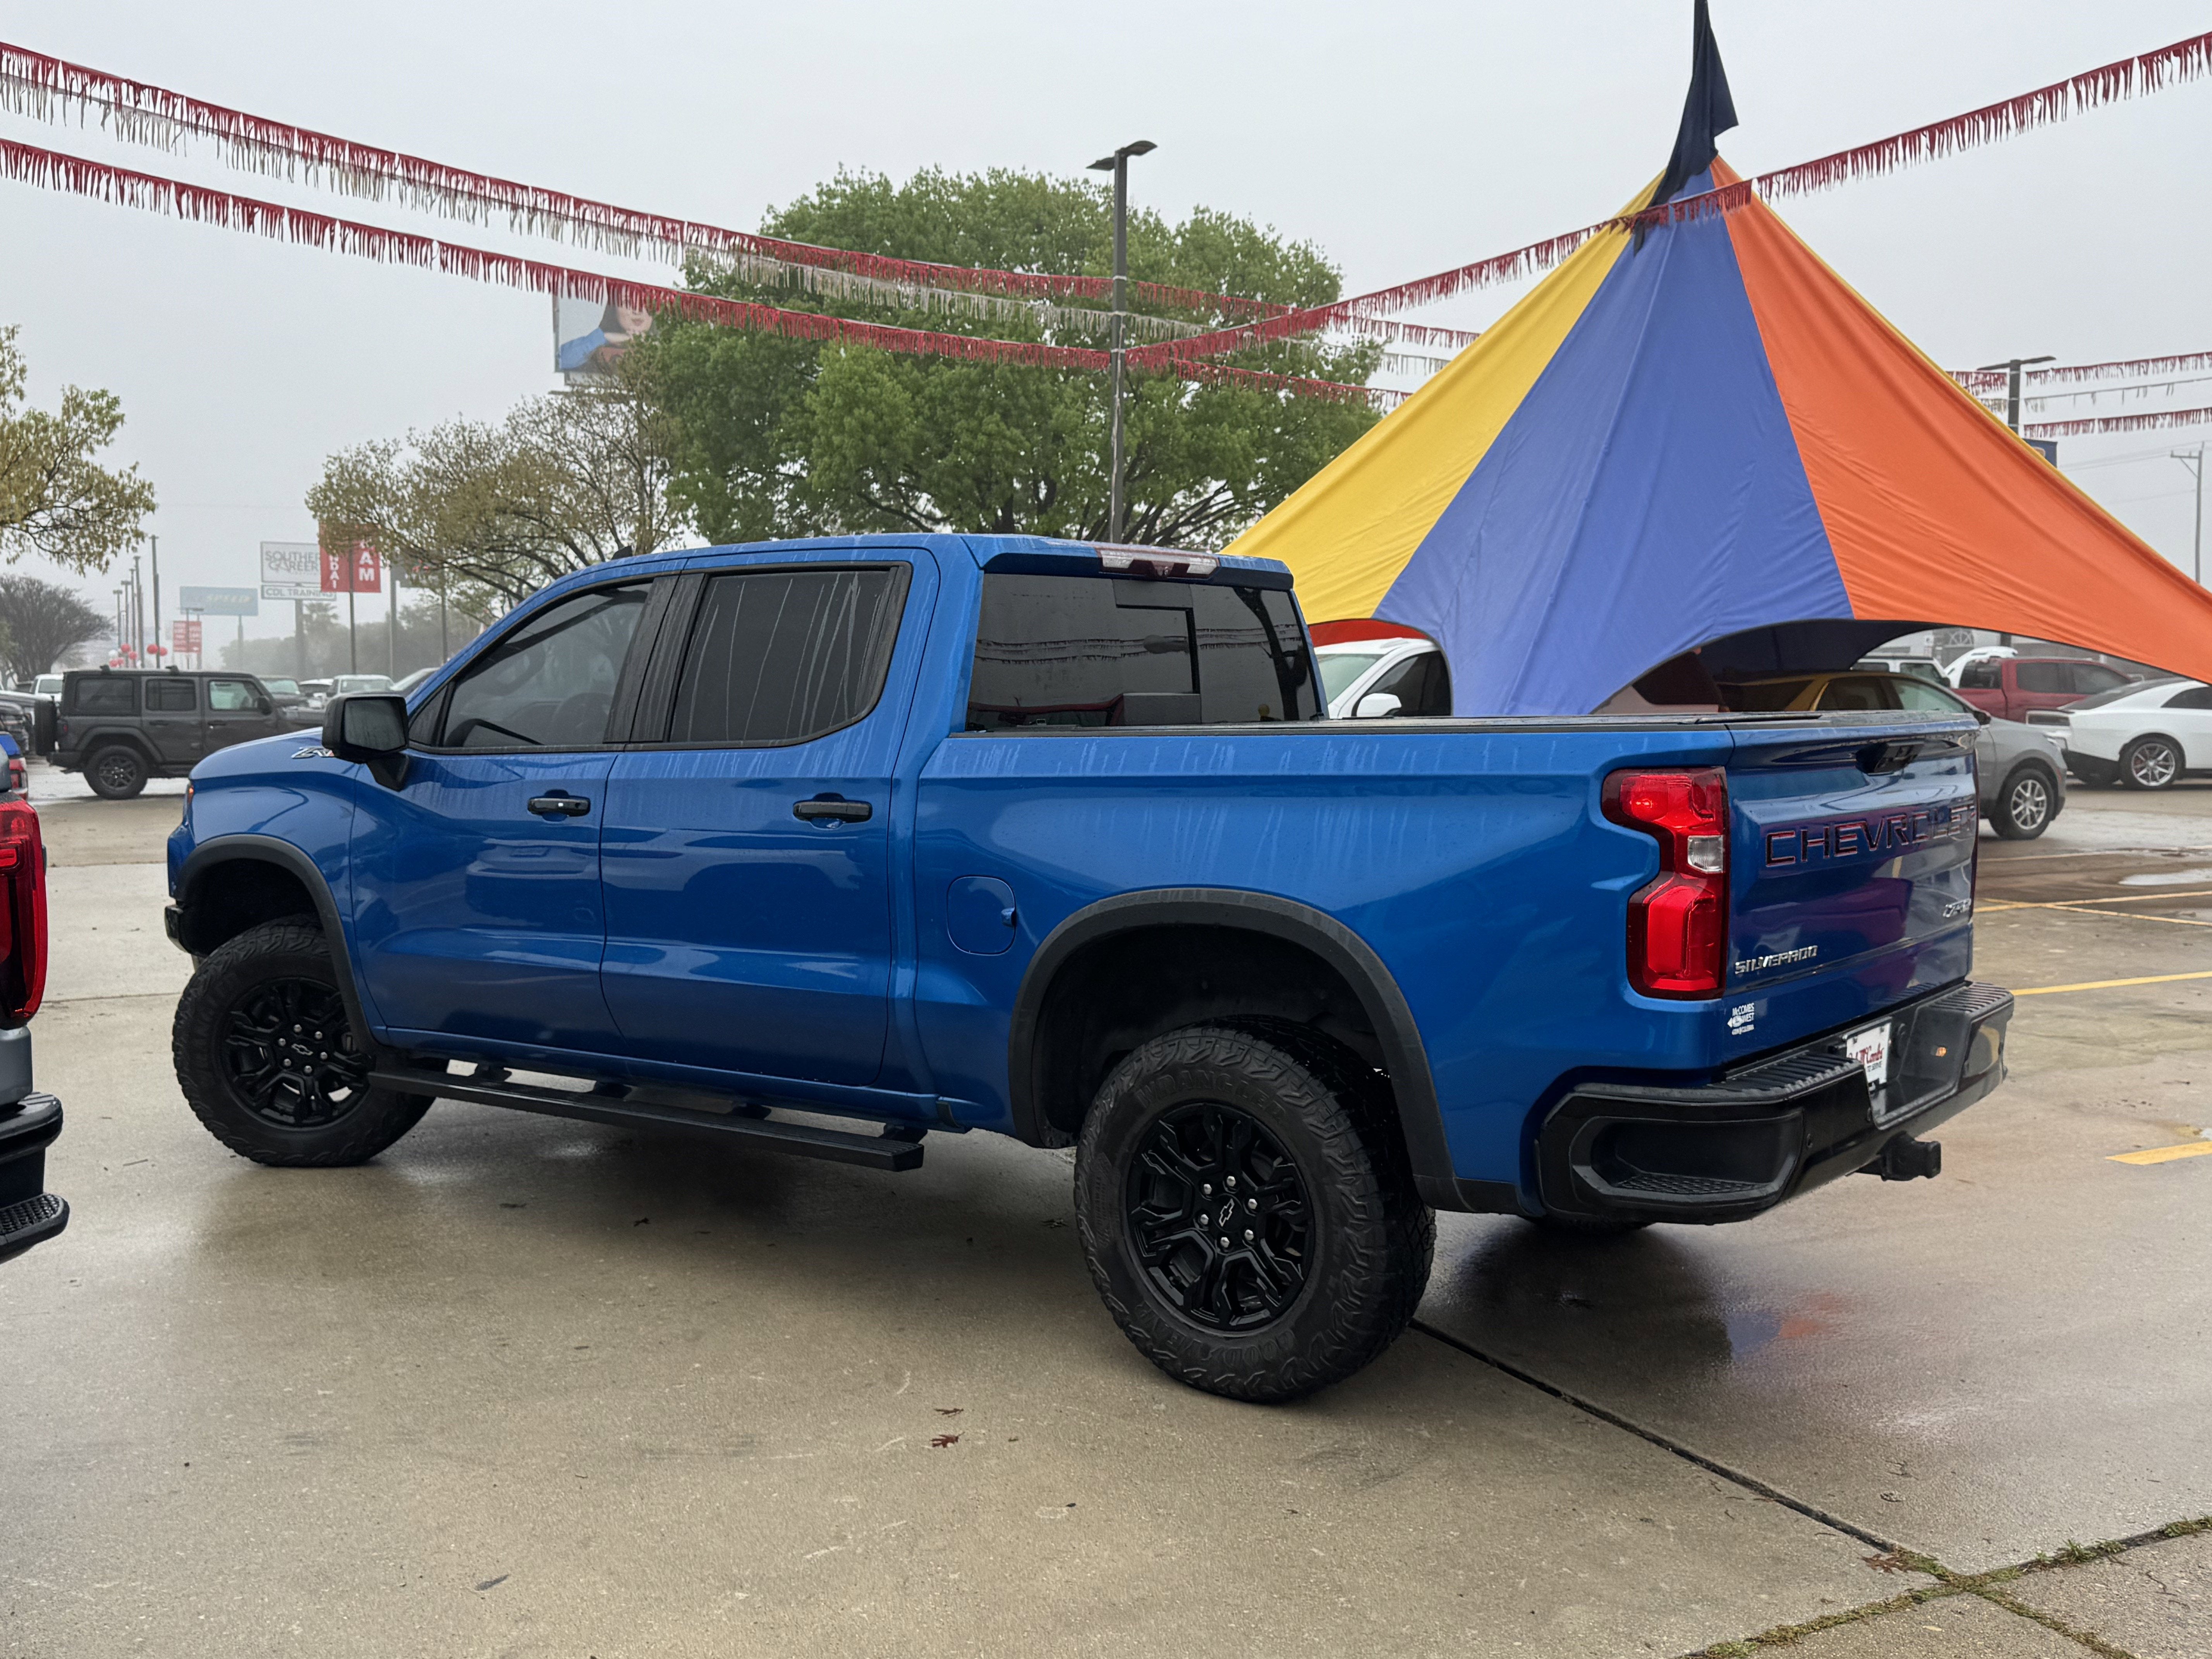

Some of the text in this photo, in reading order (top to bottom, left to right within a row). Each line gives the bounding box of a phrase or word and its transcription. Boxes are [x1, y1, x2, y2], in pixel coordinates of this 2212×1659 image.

[359, 539, 375, 581] AM
[266, 588, 285, 596] CDL
[1766, 805, 1975, 867] CHEVROLET
[1735, 945, 1818, 974] SILVERADO
[1134, 1070, 1286, 1118] WRANGLER
[1136, 1302, 1295, 1368] GOODYEAR
